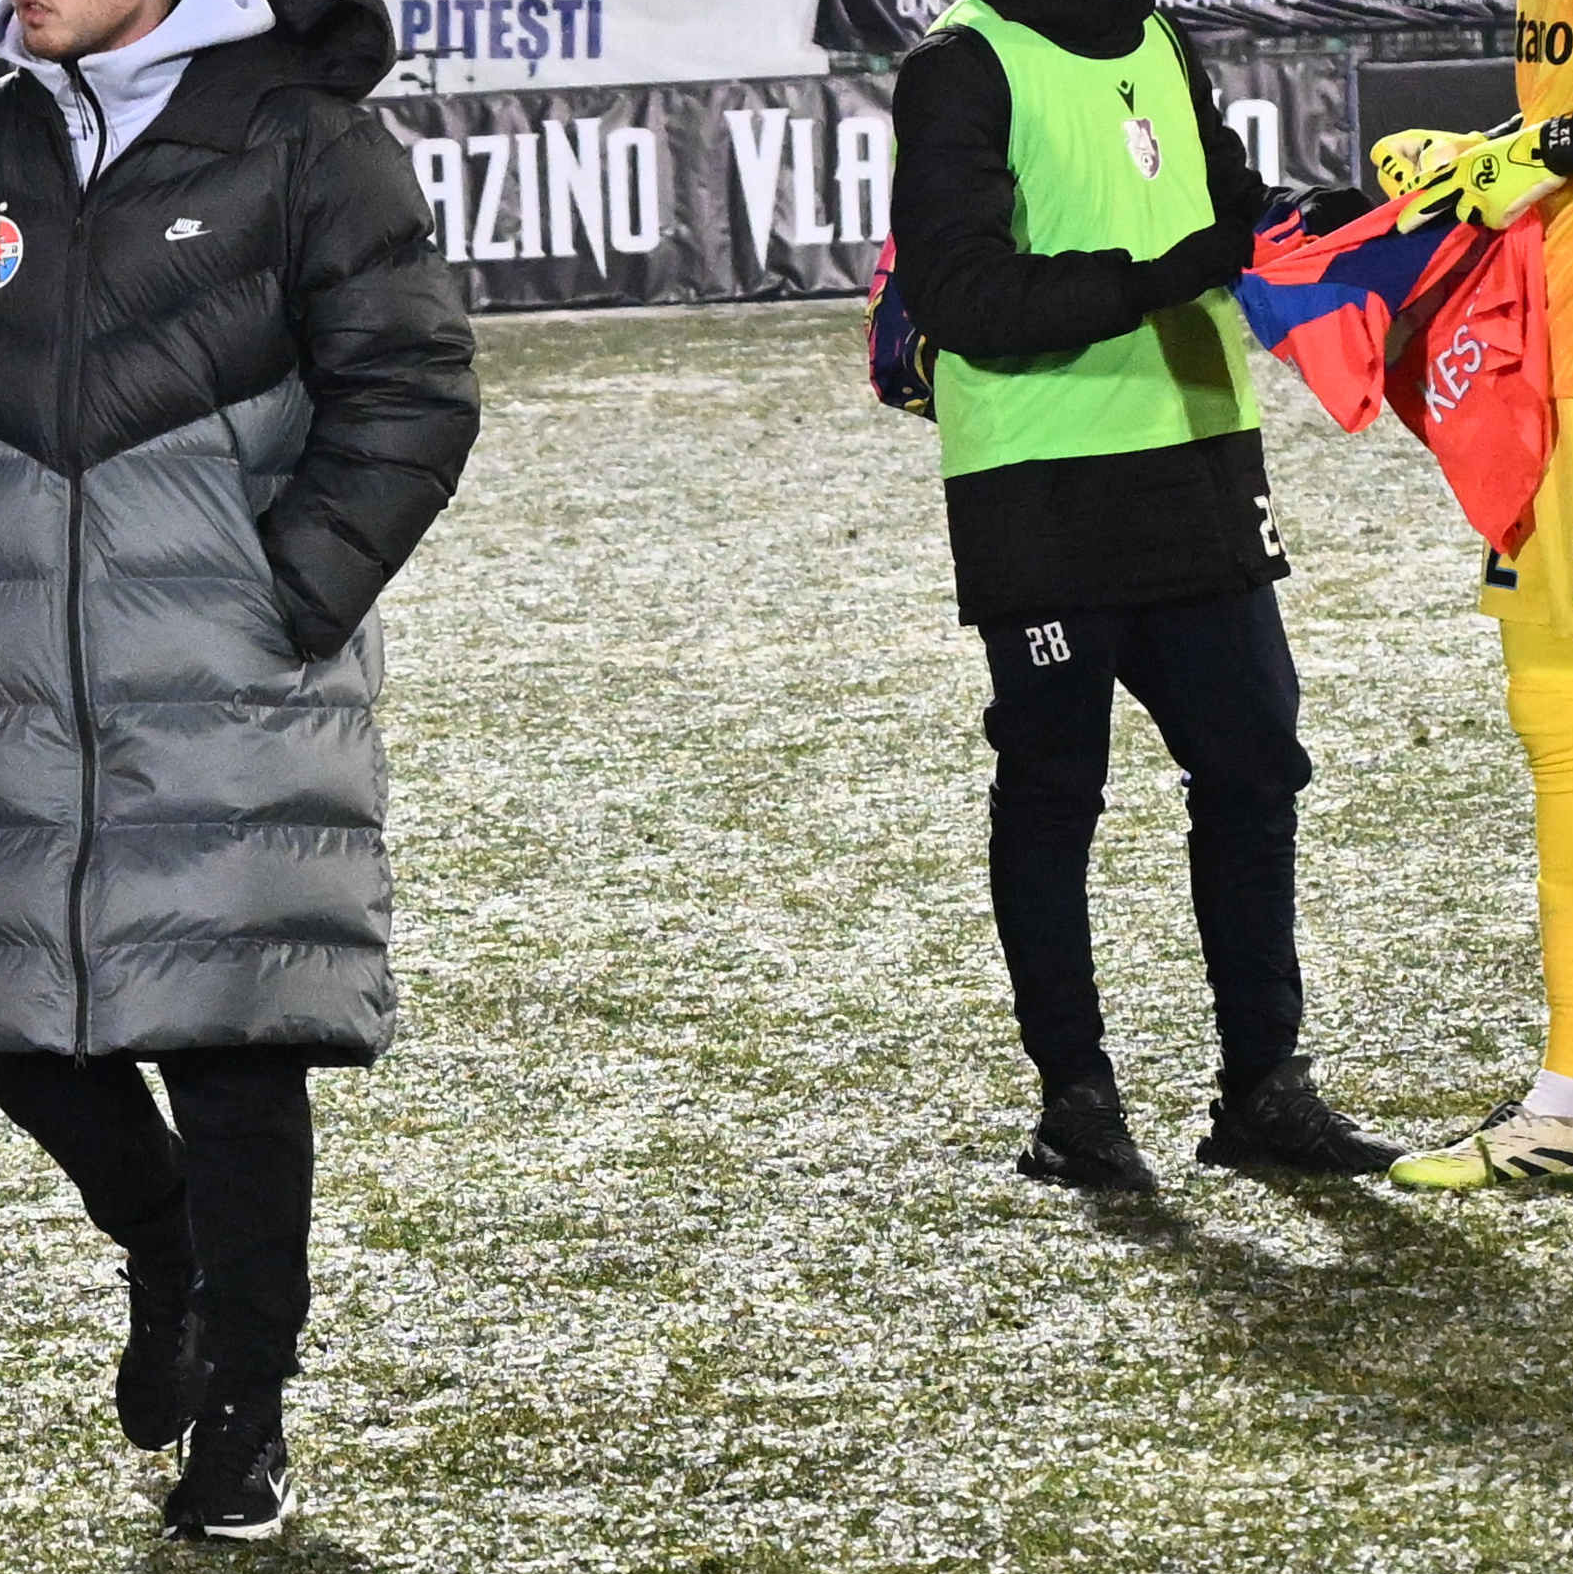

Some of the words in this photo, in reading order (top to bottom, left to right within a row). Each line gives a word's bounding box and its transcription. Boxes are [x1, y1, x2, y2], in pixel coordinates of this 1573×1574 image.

[411, 116, 662, 279] AZINO
[722, 107, 896, 274] VLA
[1025, 620, 1072, 667] 28
